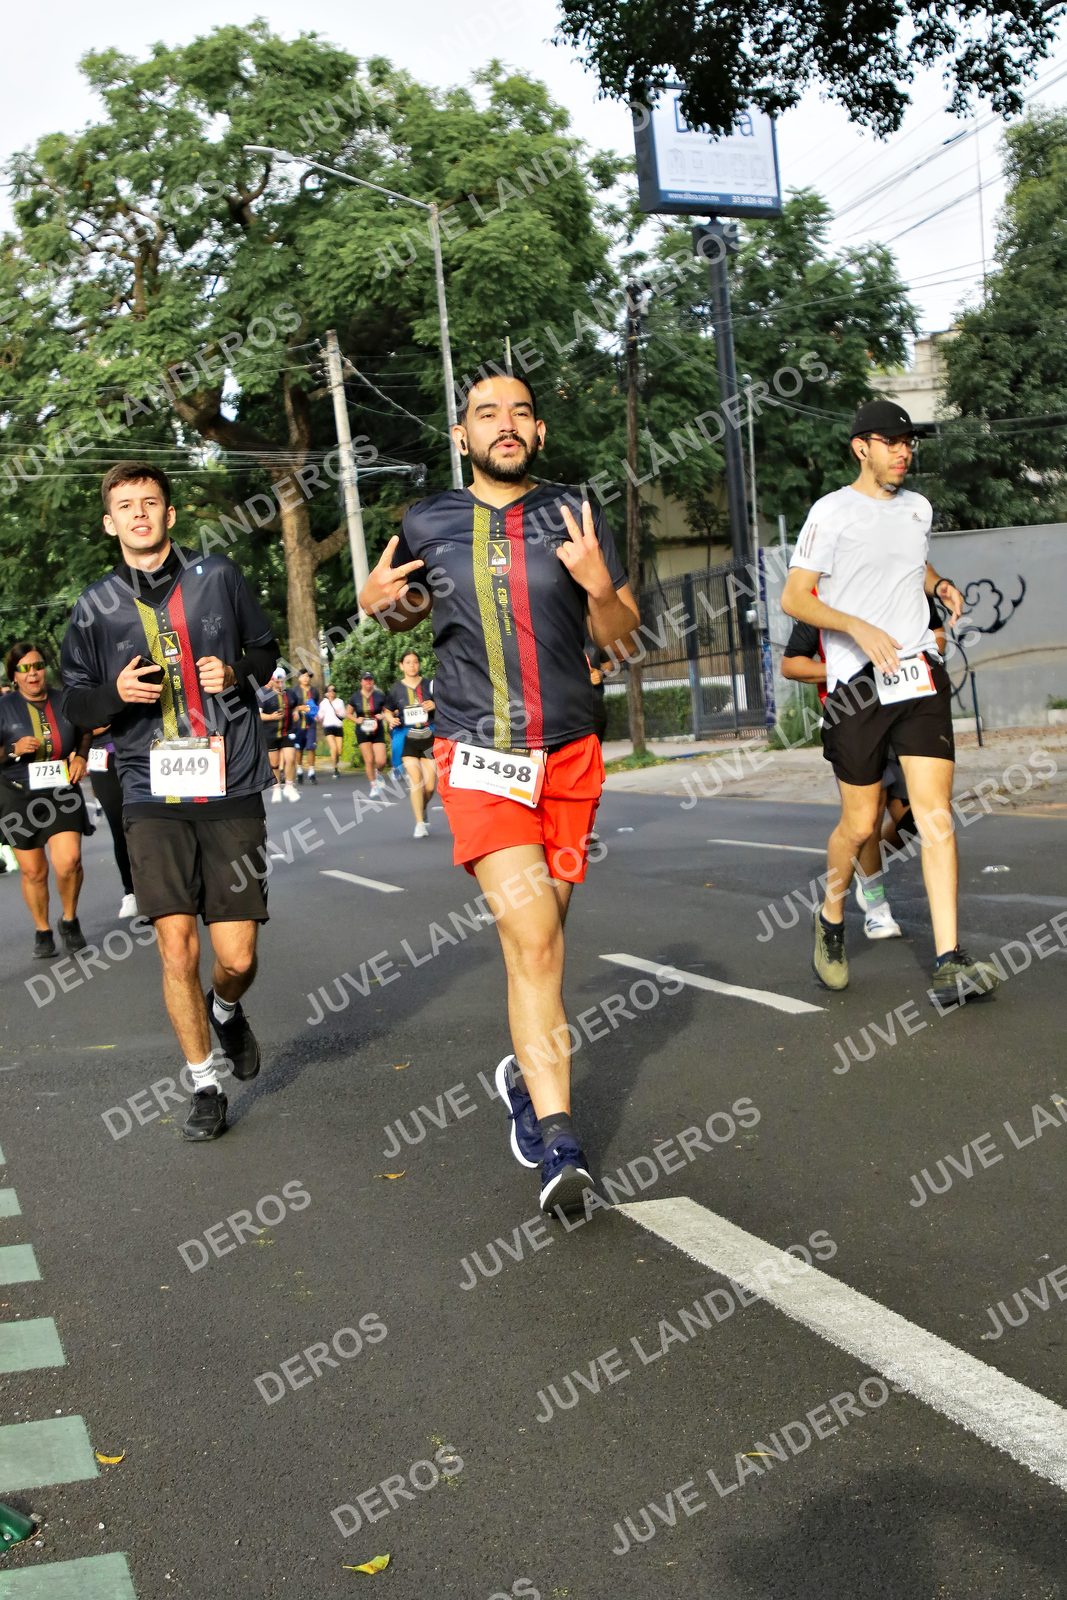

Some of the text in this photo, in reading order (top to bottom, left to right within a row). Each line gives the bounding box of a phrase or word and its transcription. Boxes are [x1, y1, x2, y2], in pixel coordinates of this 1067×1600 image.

[35, 764, 61, 777] 7734
[160, 756, 209, 776] 8449
[460, 750, 532, 783] 13498
